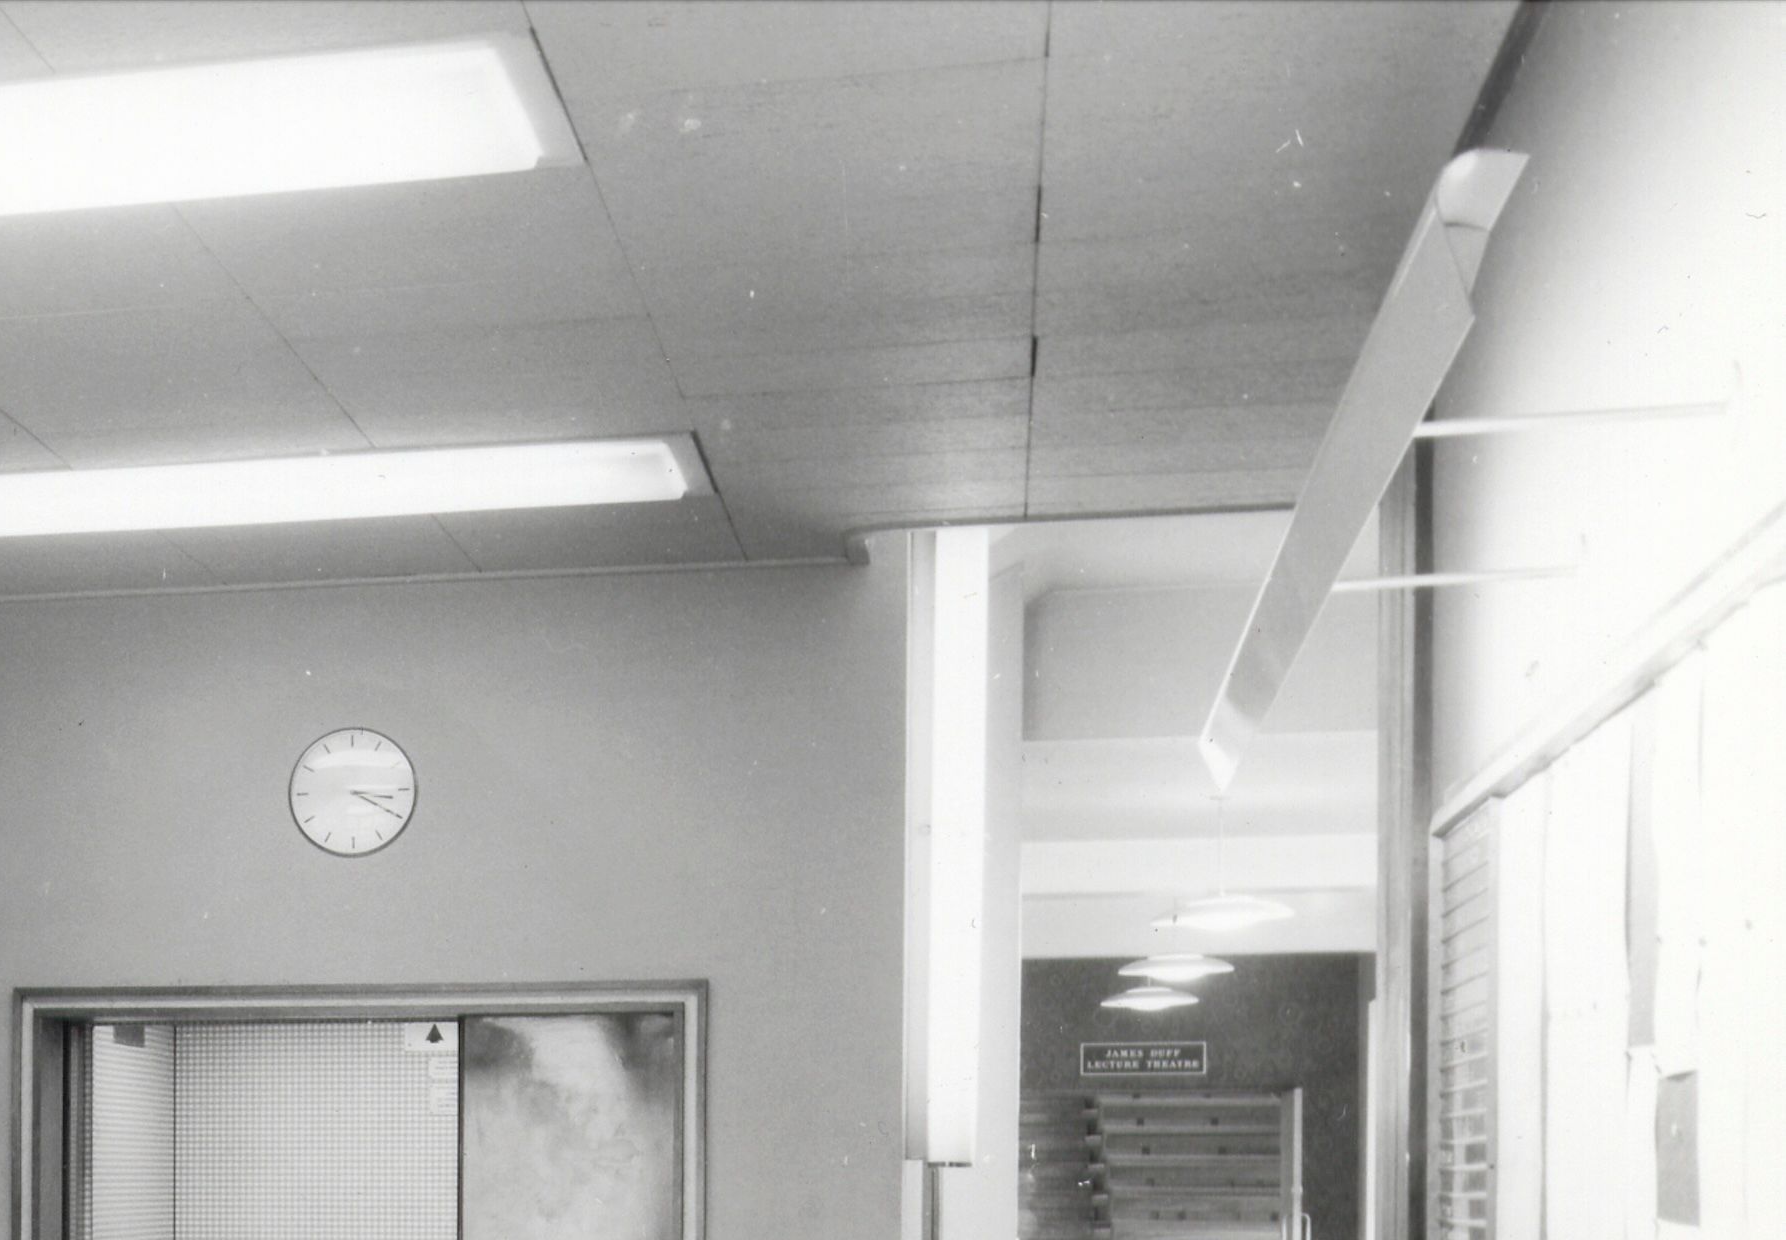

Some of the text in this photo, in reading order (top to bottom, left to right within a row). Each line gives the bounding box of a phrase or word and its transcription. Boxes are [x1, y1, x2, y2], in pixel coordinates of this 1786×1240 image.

[1105, 1049, 1181, 1058] JAMES DUFF
[1087, 1059, 1199, 1069] LECTURE THEATRE
